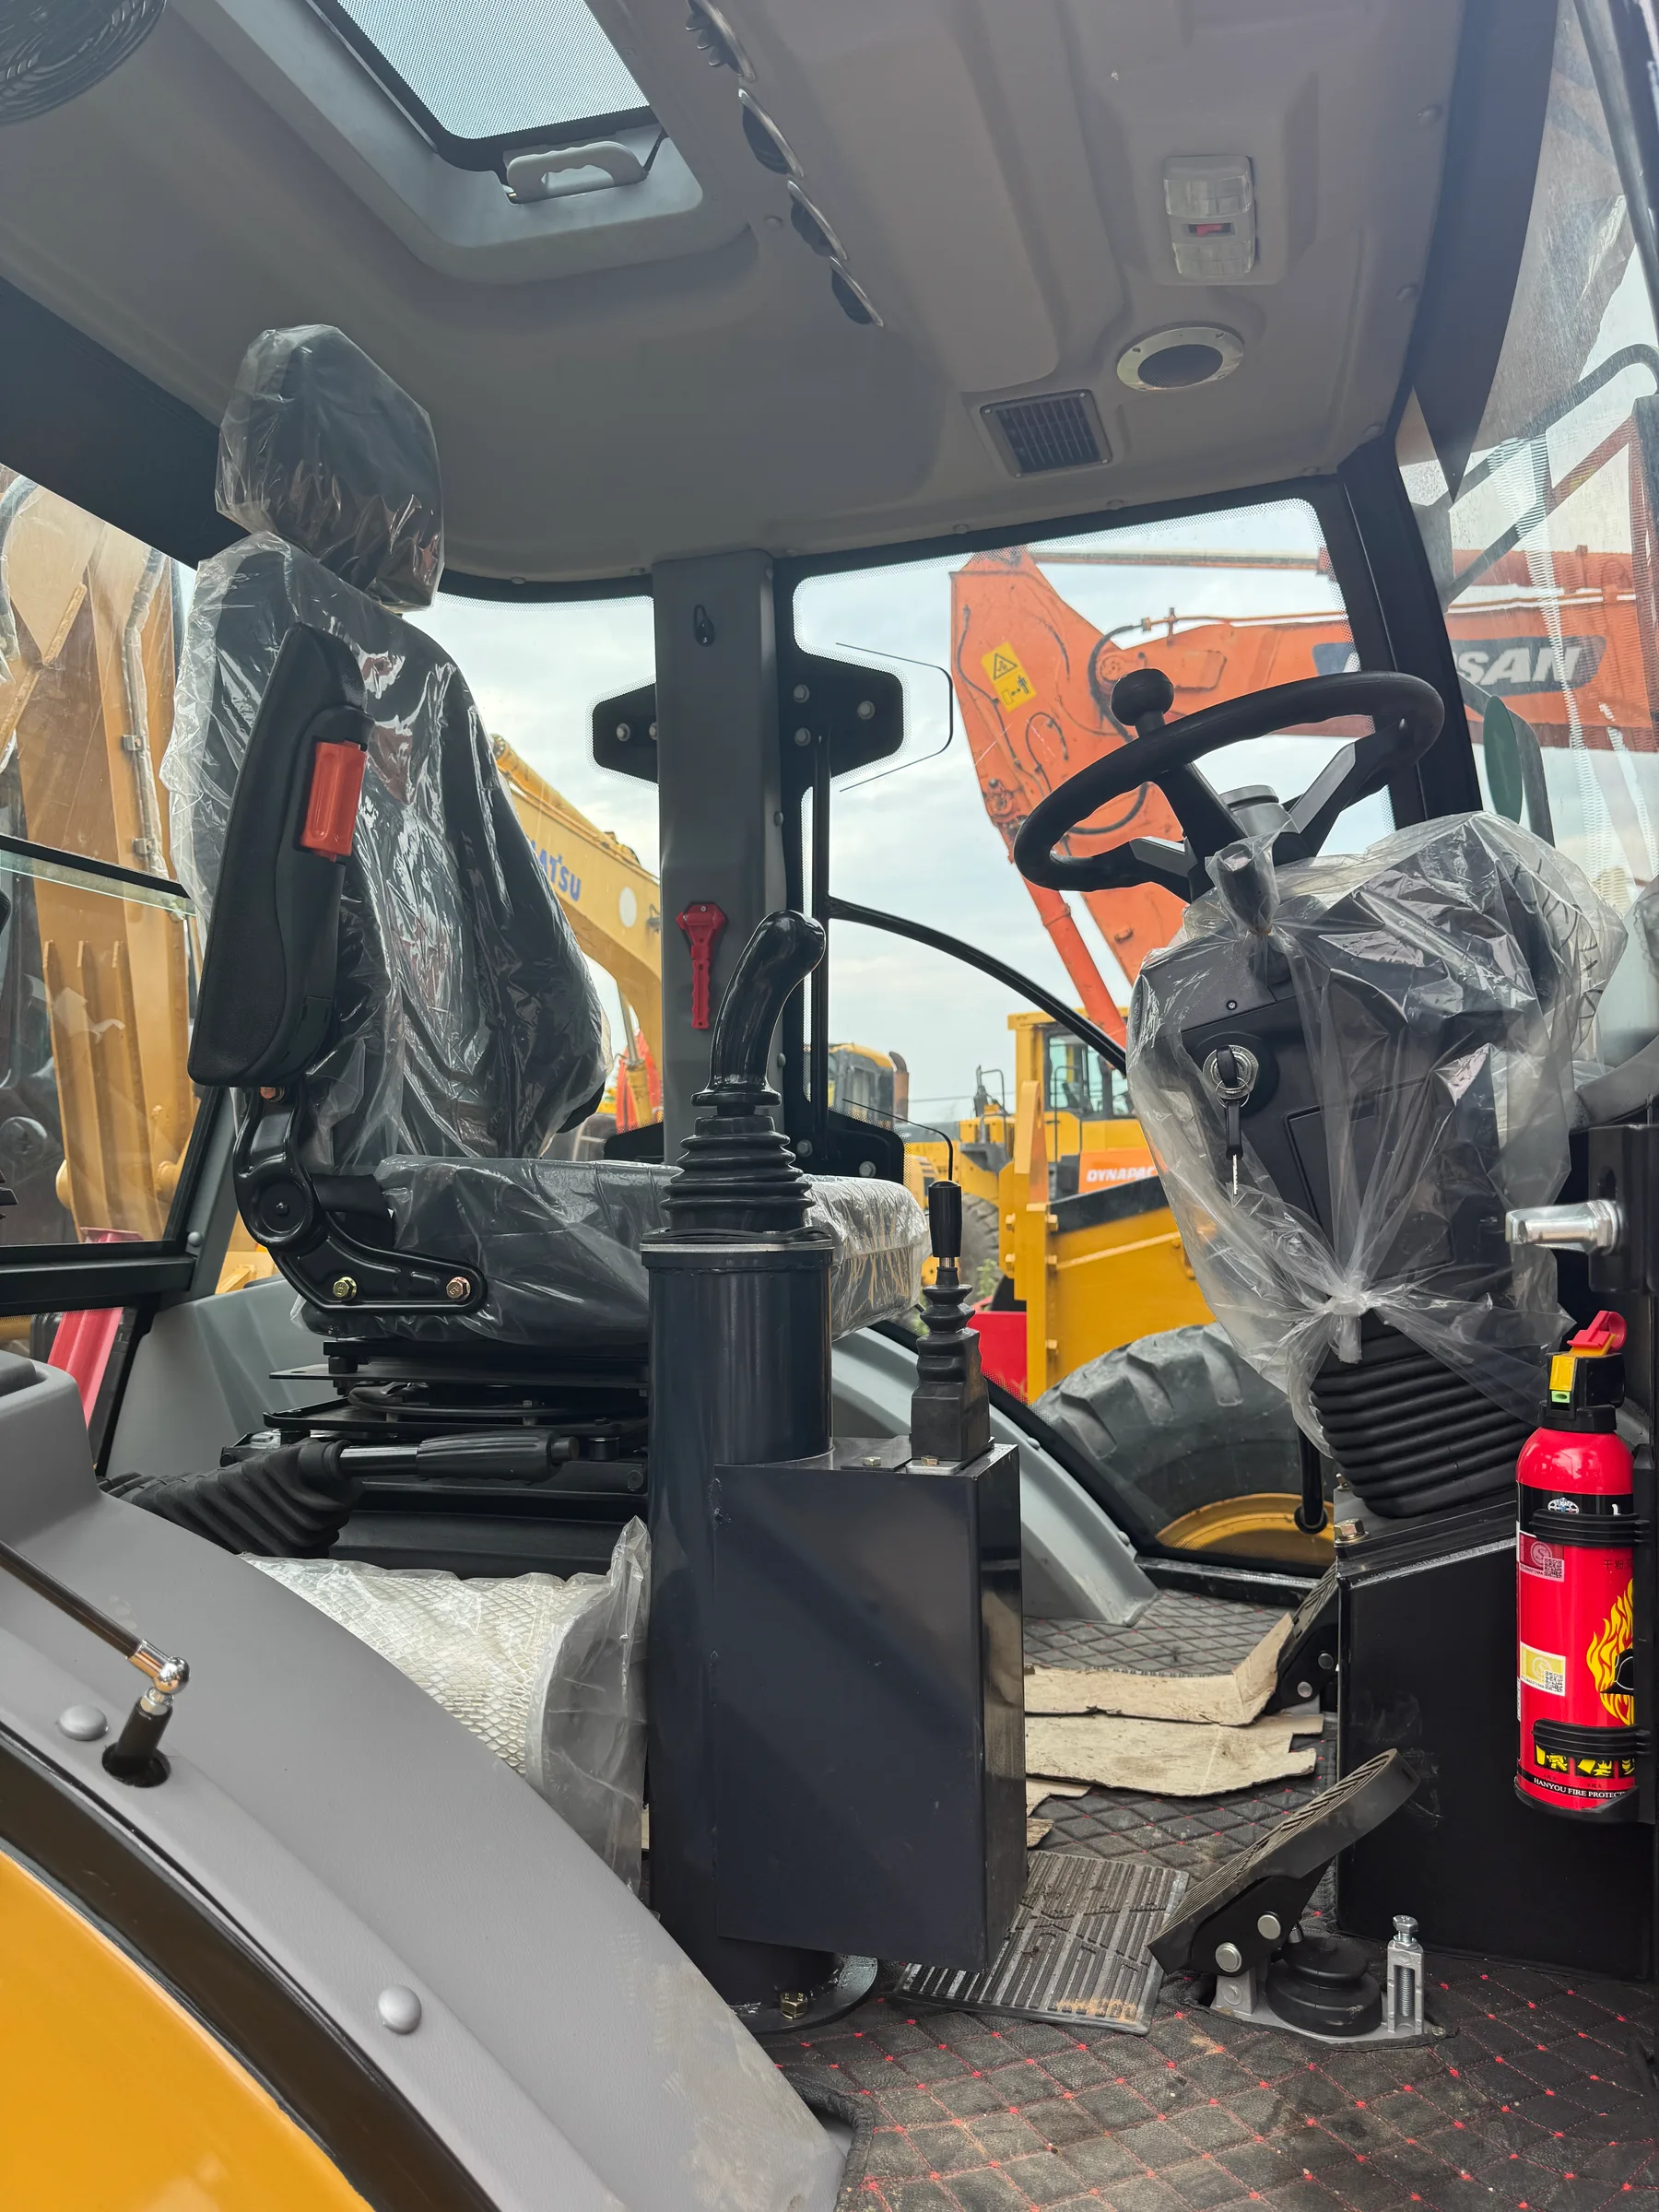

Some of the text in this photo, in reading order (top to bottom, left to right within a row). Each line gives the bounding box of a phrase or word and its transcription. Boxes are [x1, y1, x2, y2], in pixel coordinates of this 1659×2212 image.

[1453, 647, 1581, 686] SAN
[530, 840, 582, 902] ATSU
[1534, 1777, 1567, 1793] HANYOU
[1568, 1788, 1586, 1796] FIRE
